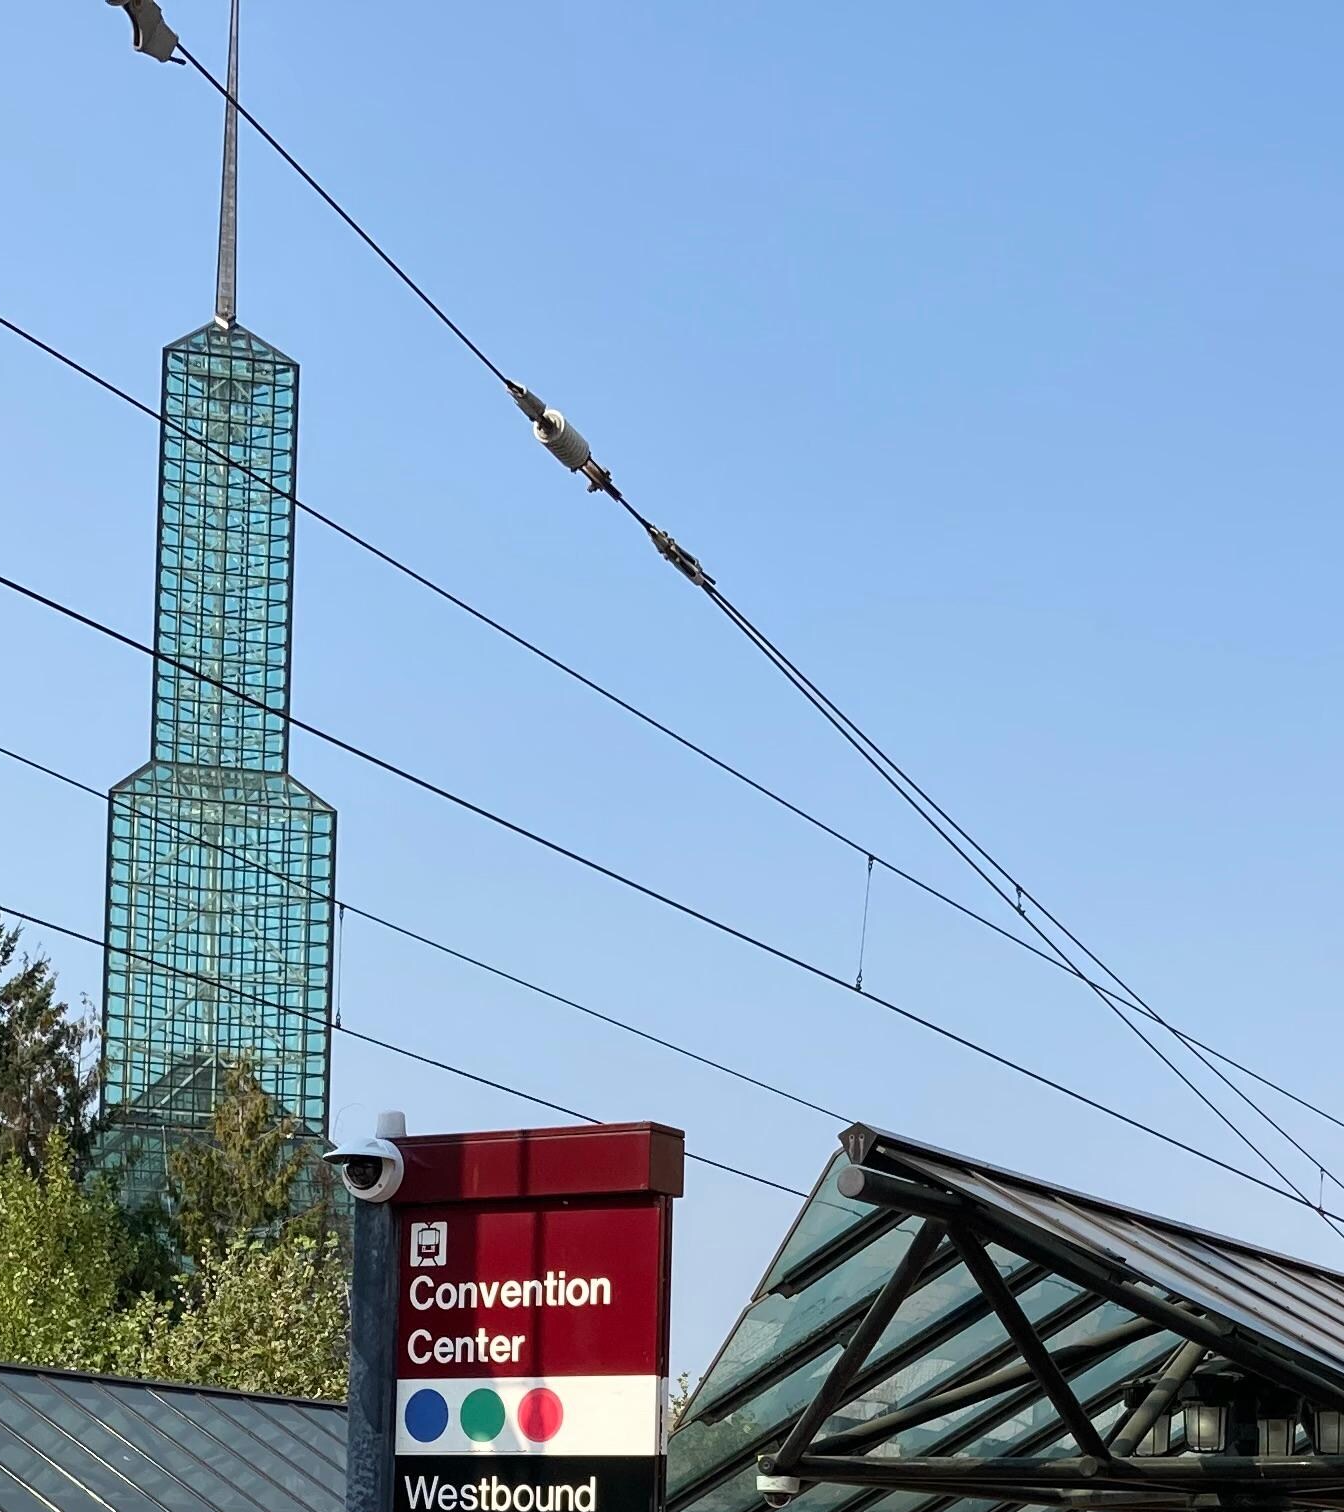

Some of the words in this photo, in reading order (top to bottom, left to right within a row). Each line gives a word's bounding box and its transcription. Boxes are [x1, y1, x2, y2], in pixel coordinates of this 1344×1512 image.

[409, 1271, 611, 1311] Convention
[407, 1327, 525, 1364] Center
[404, 1475, 597, 1512] Westbound
